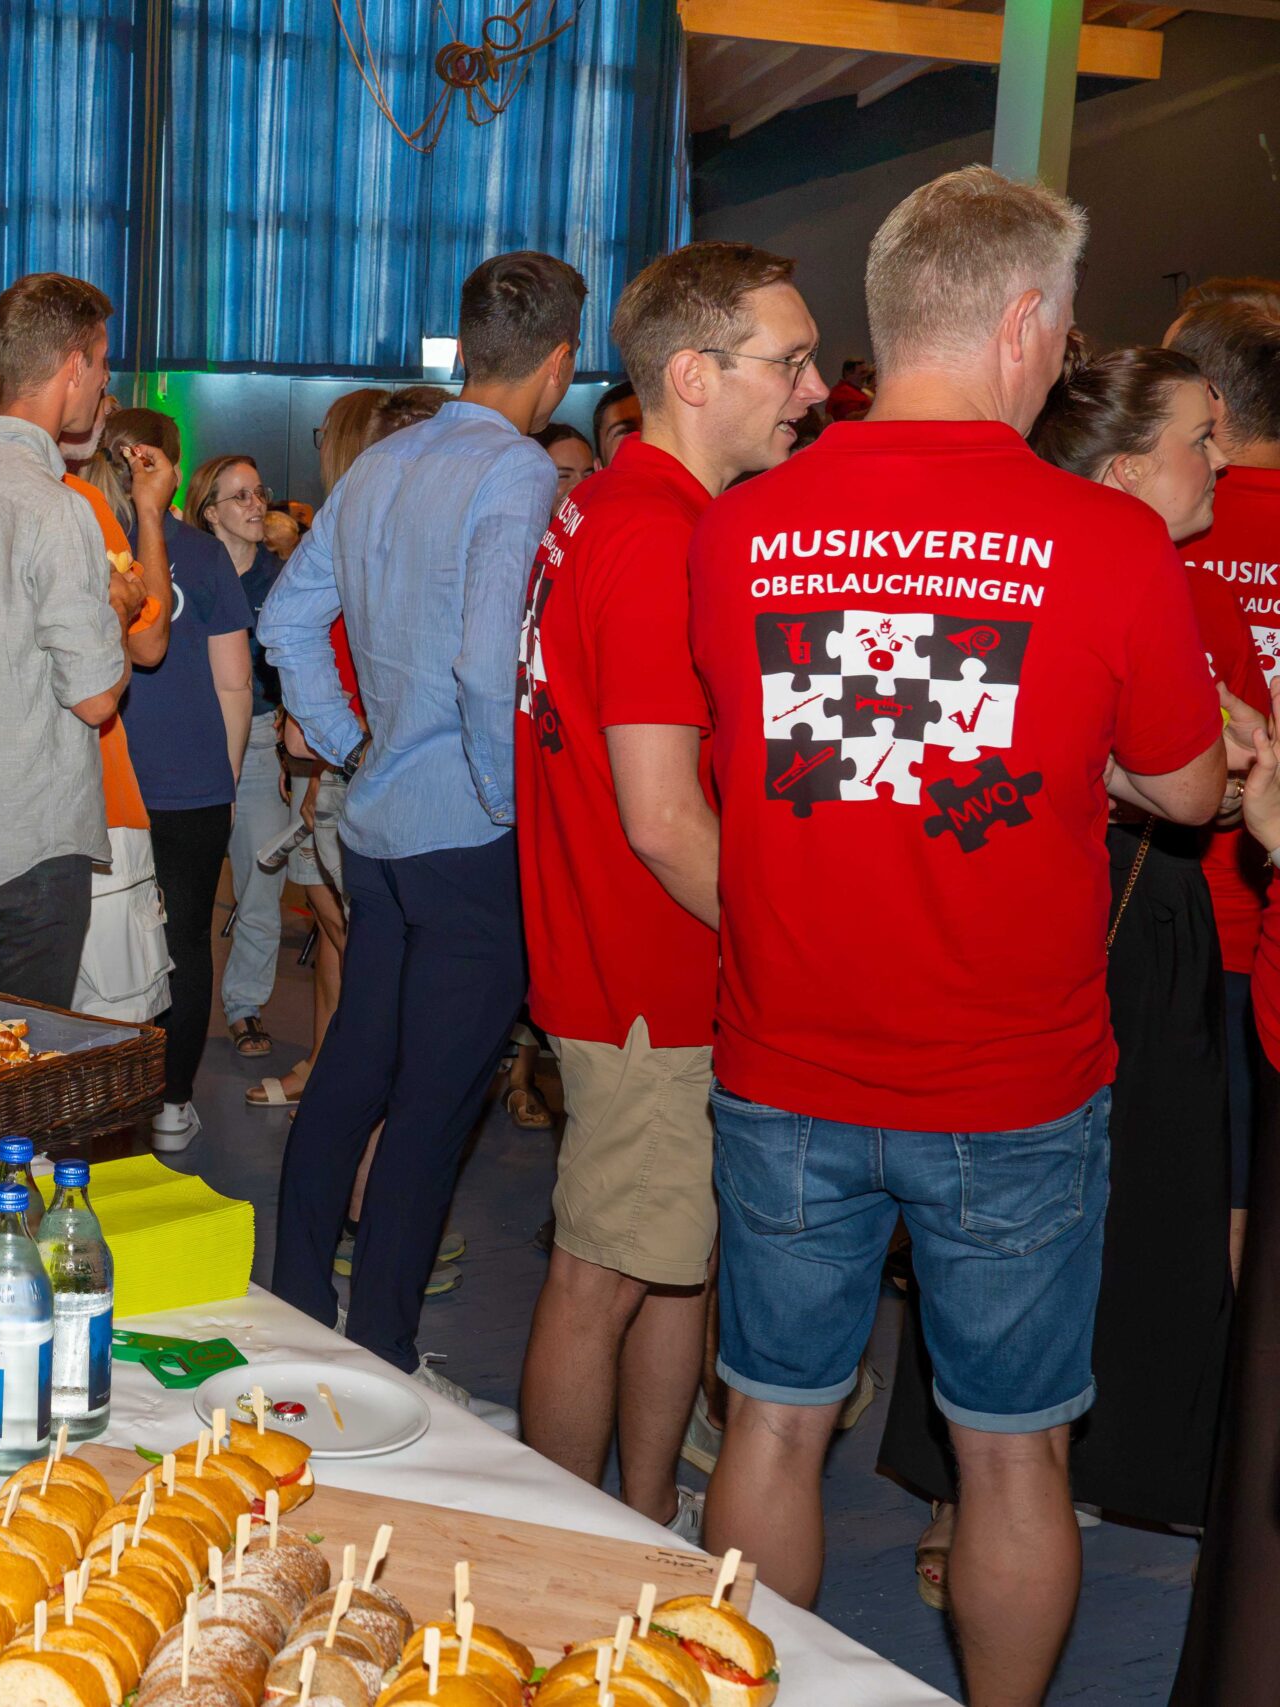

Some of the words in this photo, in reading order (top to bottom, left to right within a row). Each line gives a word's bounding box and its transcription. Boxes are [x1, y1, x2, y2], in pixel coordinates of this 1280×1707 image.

[750, 529, 1054, 569] MUSIKVEREIN
[750, 572, 1045, 607] OBERLAUCHRINGEN
[947, 782, 1019, 831] MVO
